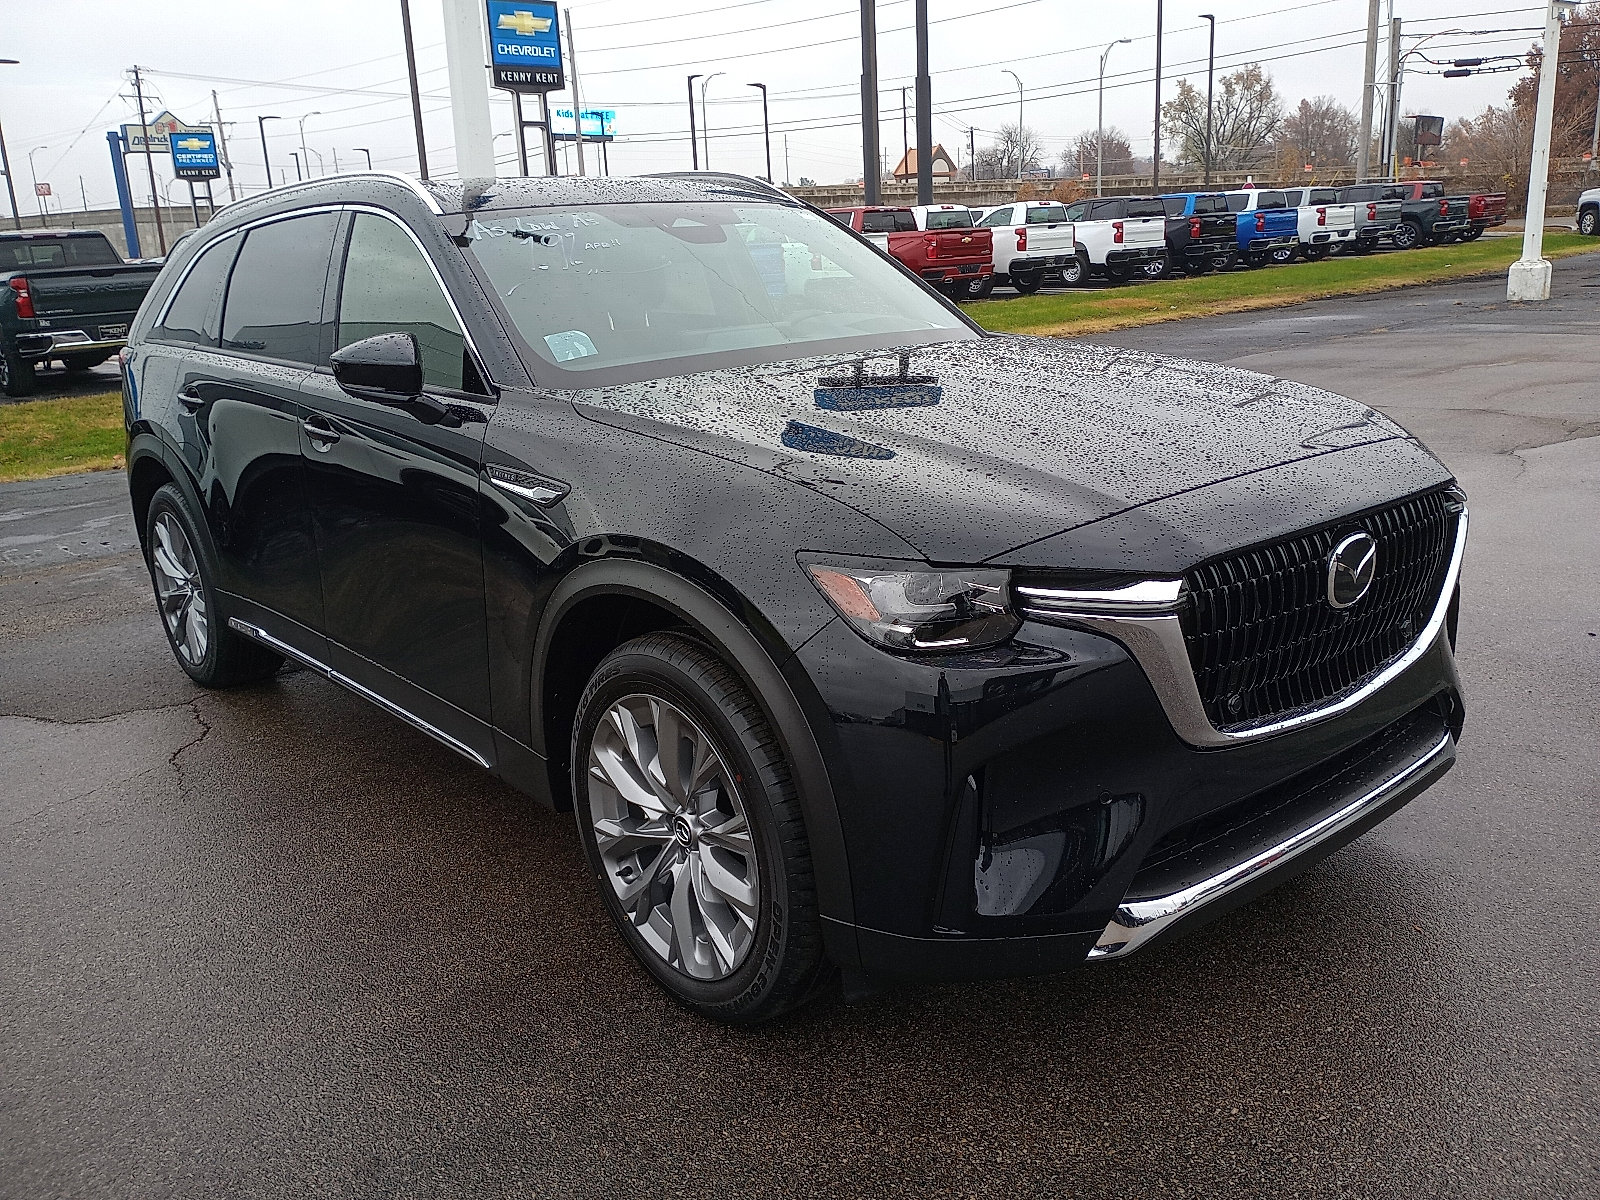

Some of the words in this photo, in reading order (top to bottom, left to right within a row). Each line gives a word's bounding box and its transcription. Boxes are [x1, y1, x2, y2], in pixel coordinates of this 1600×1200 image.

[497, 43, 556, 58] CHEVROLET
[501, 70, 532, 82] KENNY
[535, 72, 559, 84] KENT
[556, 109, 574, 118] Kids
